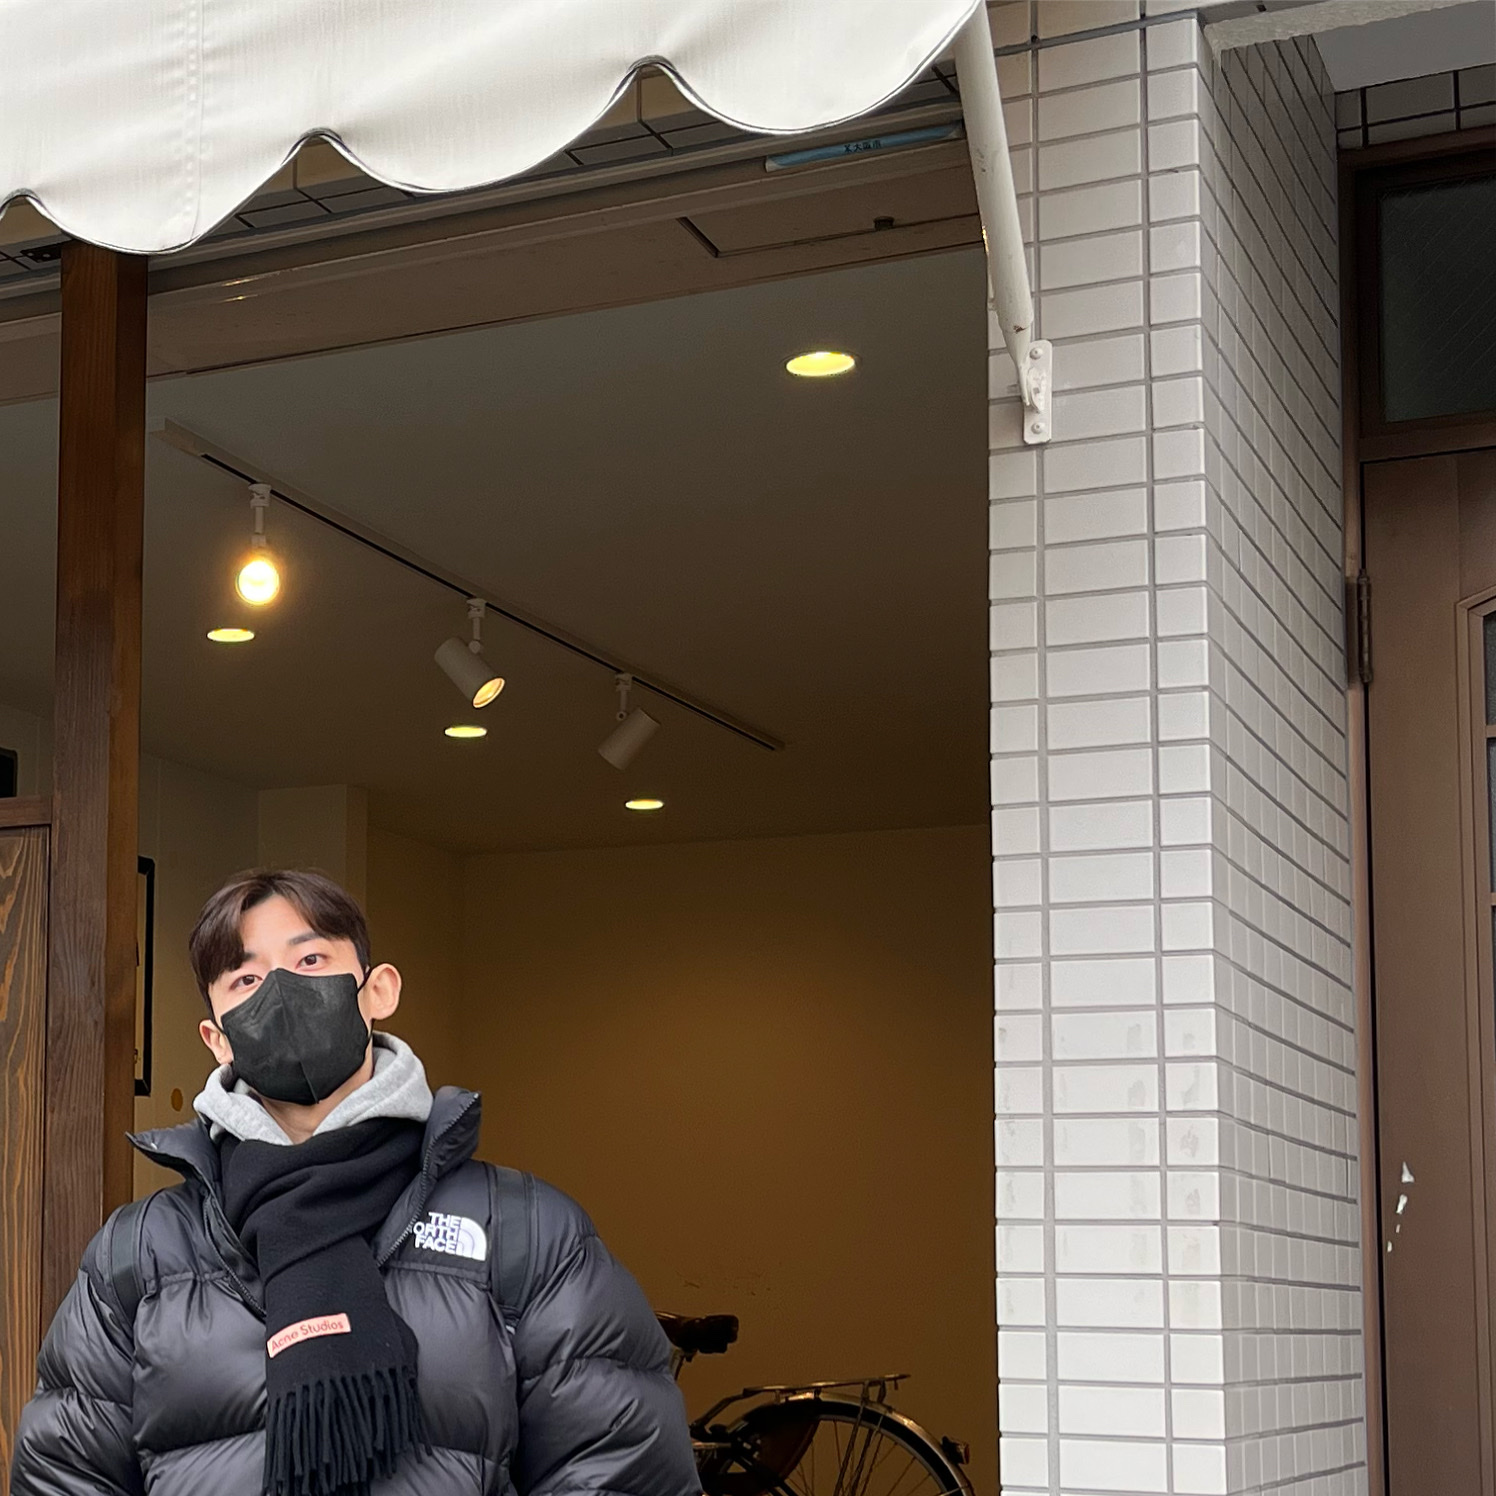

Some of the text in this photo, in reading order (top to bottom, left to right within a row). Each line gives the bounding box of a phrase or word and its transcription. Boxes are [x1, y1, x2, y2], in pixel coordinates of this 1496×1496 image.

[428, 1211, 461, 1229] THE
[412, 1221, 459, 1241] ORTH
[414, 1234, 457, 1255] FACE
[299, 1320, 344, 1336] Studios
